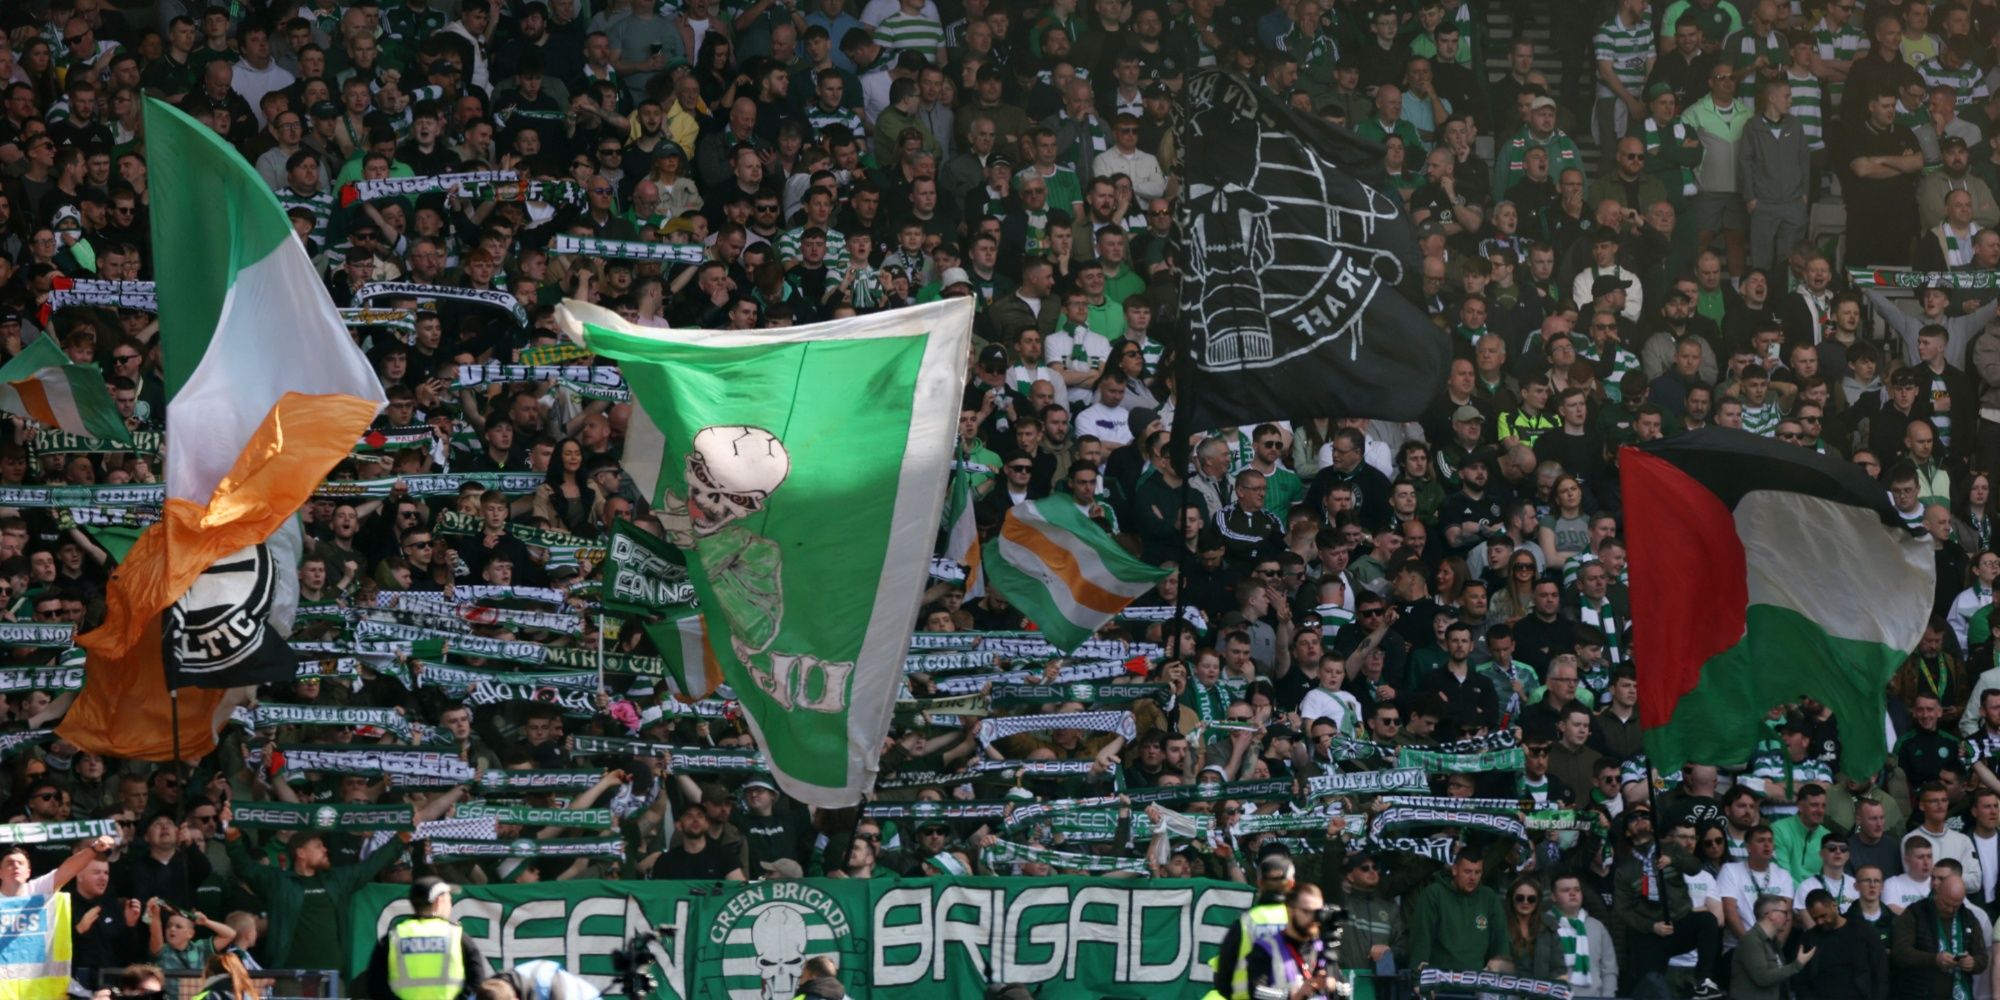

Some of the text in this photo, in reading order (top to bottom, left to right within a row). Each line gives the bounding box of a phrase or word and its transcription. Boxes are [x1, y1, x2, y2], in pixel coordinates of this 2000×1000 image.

[478, 288, 508, 304] CSC
[461, 365, 622, 387] ULTRAS
[409, 476, 459, 491] TRAS
[922, 655, 963, 670] CON
[966, 653, 995, 667] NO
[0, 668, 84, 690] ELTIC
[991, 685, 1063, 698] GREEN
[343, 707, 381, 722] CON
[1380, 769, 1416, 788] CON
[1226, 780, 1291, 795] BRIGAD
[235, 808, 411, 824] GREEN BRIGADE
[527, 808, 611, 824] BRIGADE
[1053, 811, 1119, 828] GREEN
[48, 819, 117, 839] CELTIC
[711, 883, 851, 945] GREEN BRIGADE
[874, 886, 1253, 985] BRIGADE
[402, 938, 446, 952] POLICE
